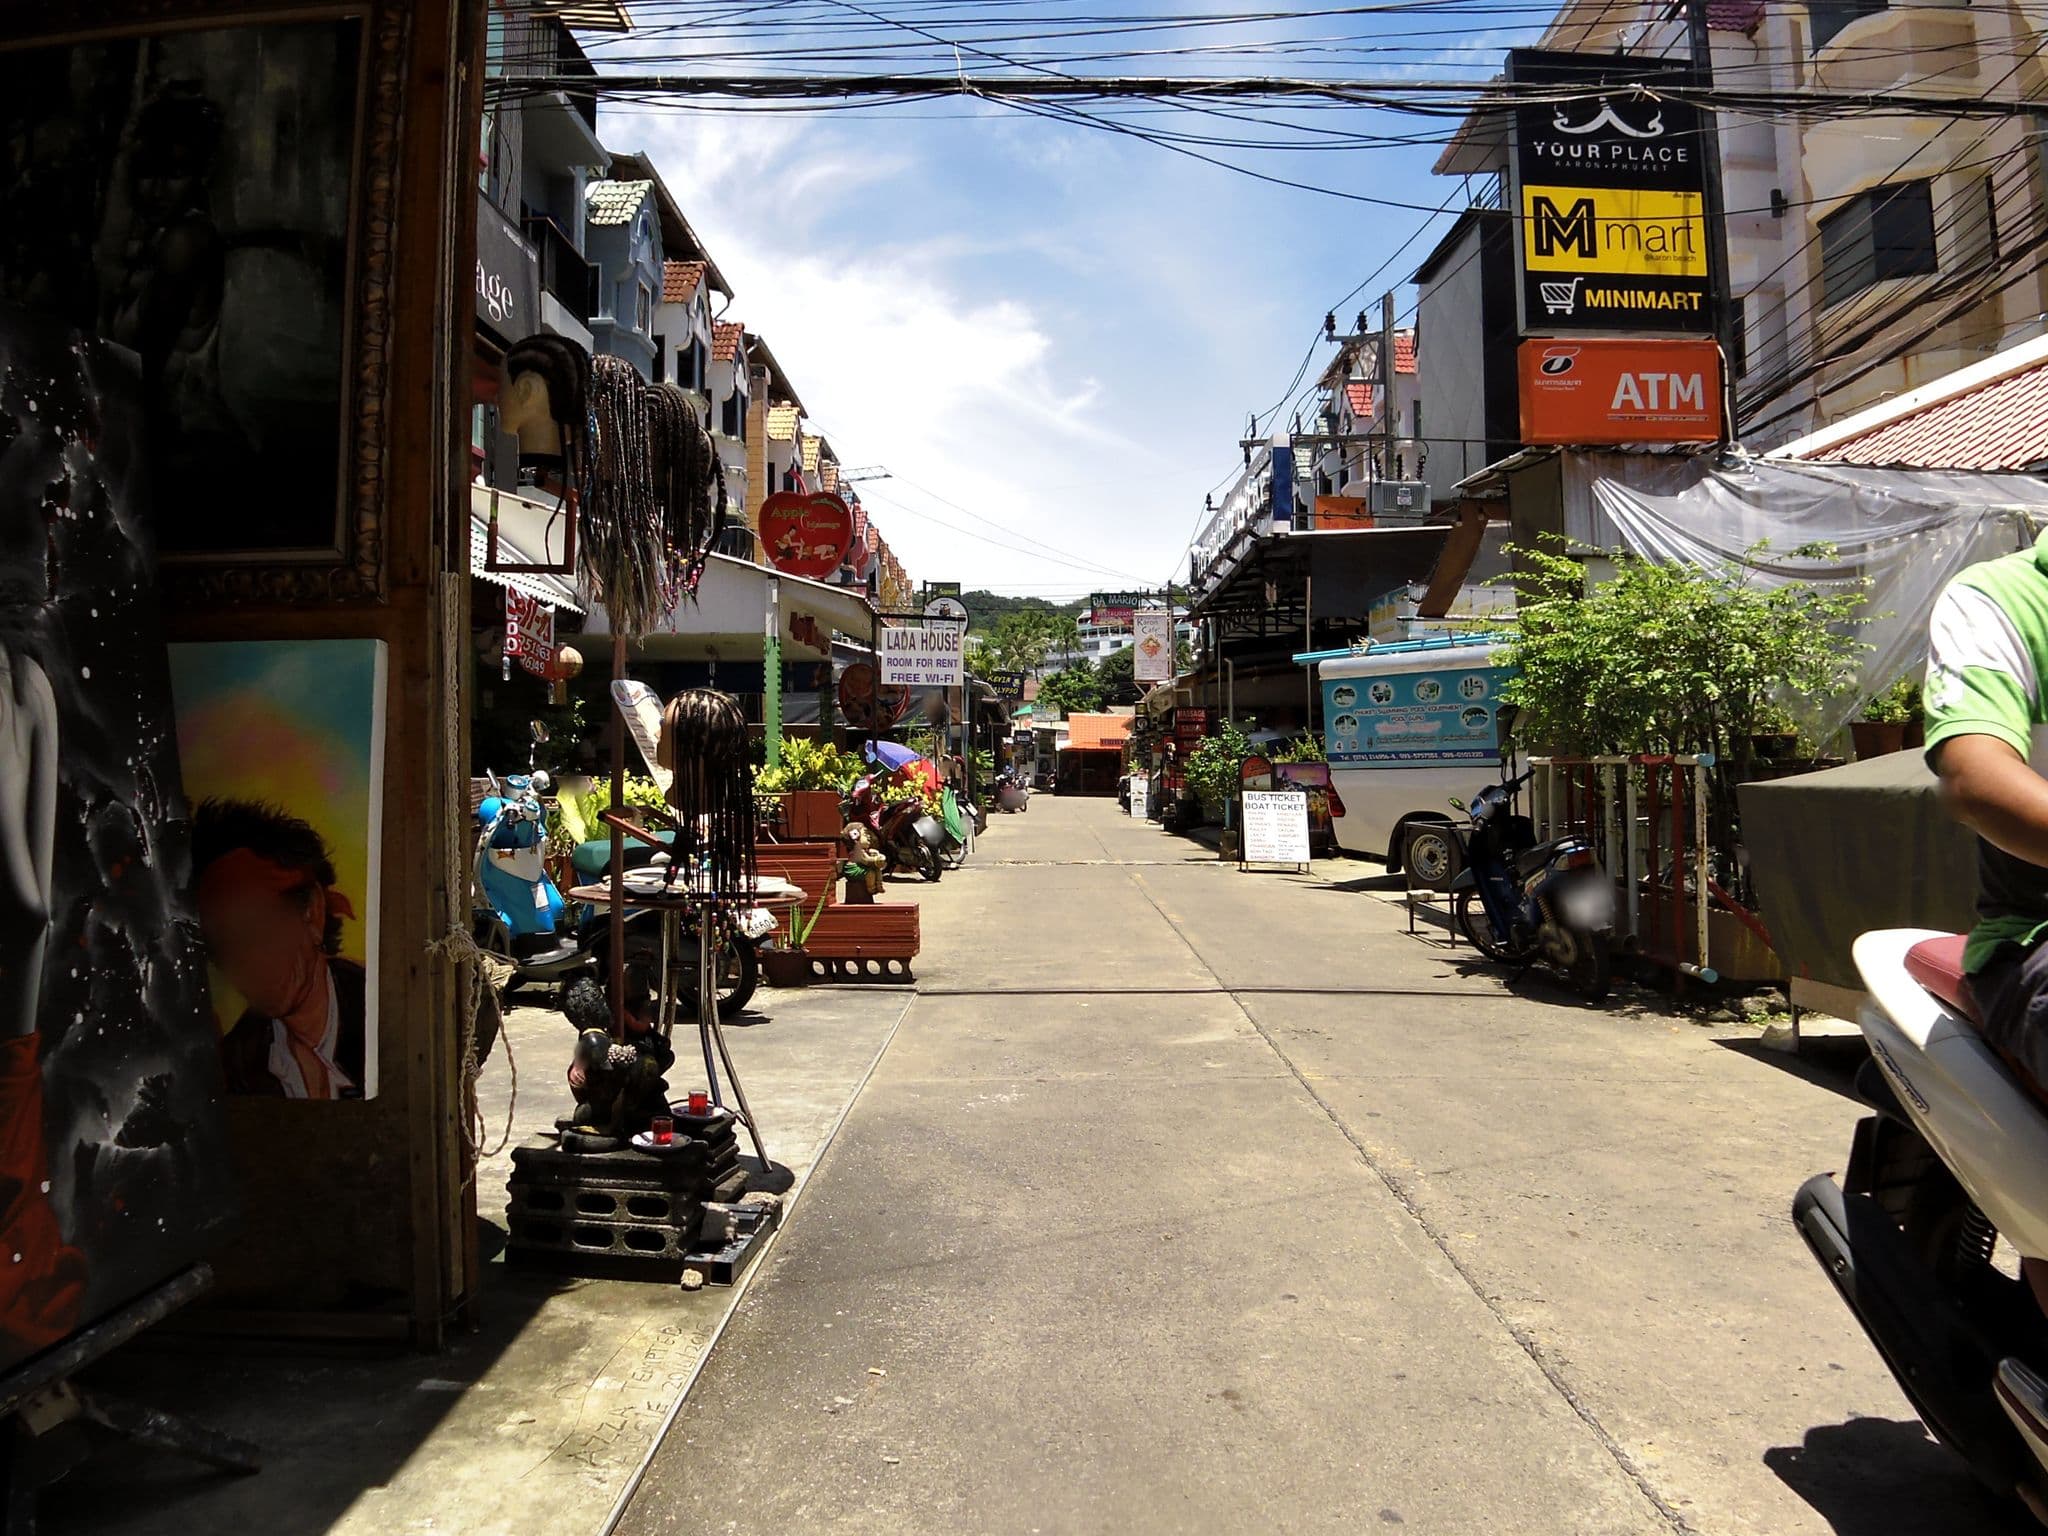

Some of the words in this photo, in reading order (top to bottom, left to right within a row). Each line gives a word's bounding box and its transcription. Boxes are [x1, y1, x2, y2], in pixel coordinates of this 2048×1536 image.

[1533, 141, 1601, 159] YOUR
[1611, 145, 1688, 163] PLACE
[1555, 160, 1600, 169] KARON
[1612, 162, 1668, 171] PHUKET
[1606, 219, 1696, 254] mart
[1585, 288, 1703, 311] MINIMART
[1610, 372, 1704, 410] ATM
[1092, 596, 1106, 607] DA
[1108, 594, 1138, 605] MARIO
[886, 631, 916, 650] LADA
[921, 632, 958, 652] HOUSE
[886, 657, 912, 667] ROOM
[916, 658, 932, 668] FOR
[936, 659, 958, 668] RENT
[890, 672, 920, 683] FREE
[926, 673, 954, 684] WI-FI
[1247, 793, 1267, 801] BUS
[1269, 794, 1301, 802] TICKET
[1245, 802, 1270, 810] BOAT
[1272, 803, 1305, 811] TICKET
